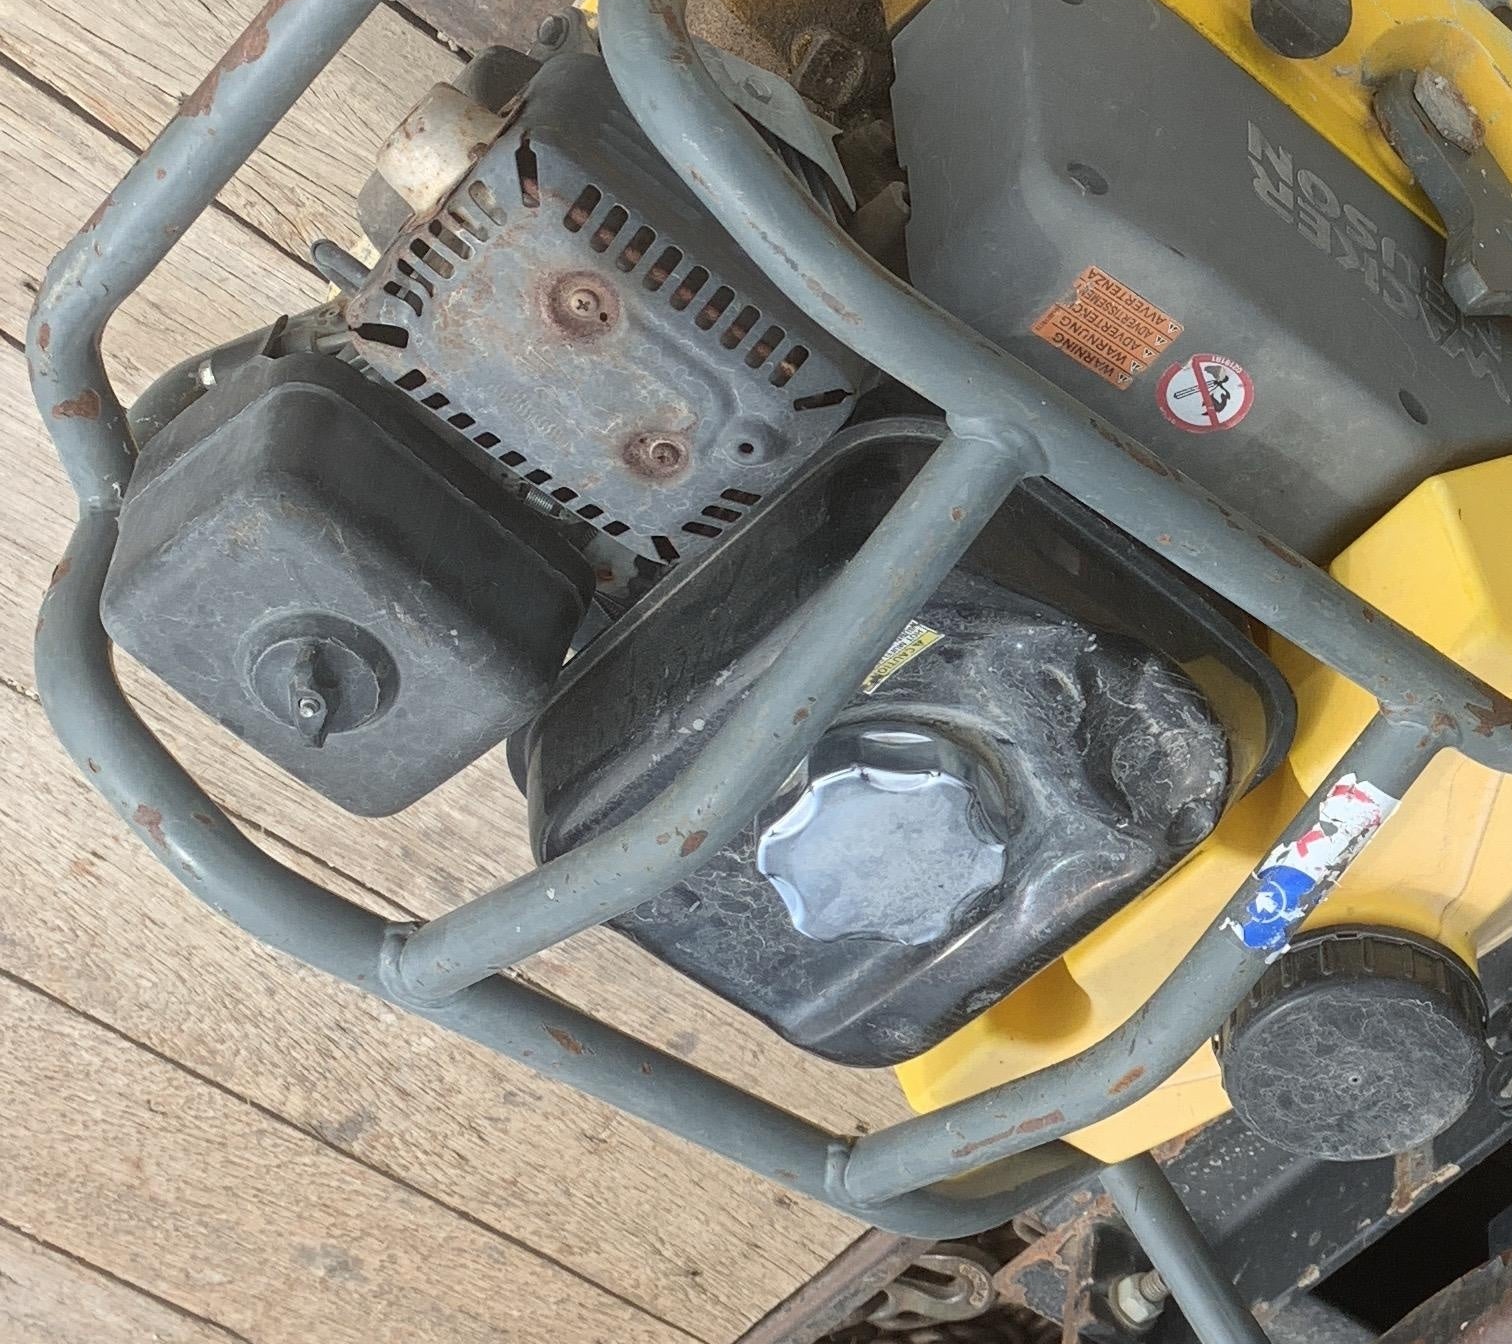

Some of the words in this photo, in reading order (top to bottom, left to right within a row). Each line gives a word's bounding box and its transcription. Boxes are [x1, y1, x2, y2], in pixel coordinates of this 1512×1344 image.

[1248, 120, 1502, 362] NEUSON
[1087, 268, 1168, 326] AVVERTENZA
[1248, 156, 1512, 405] WACKER
[1059, 316, 1128, 365] WARNUNG
[1068, 301, 1141, 351] ADVERTENC
[1052, 332, 1115, 378] WARNING
